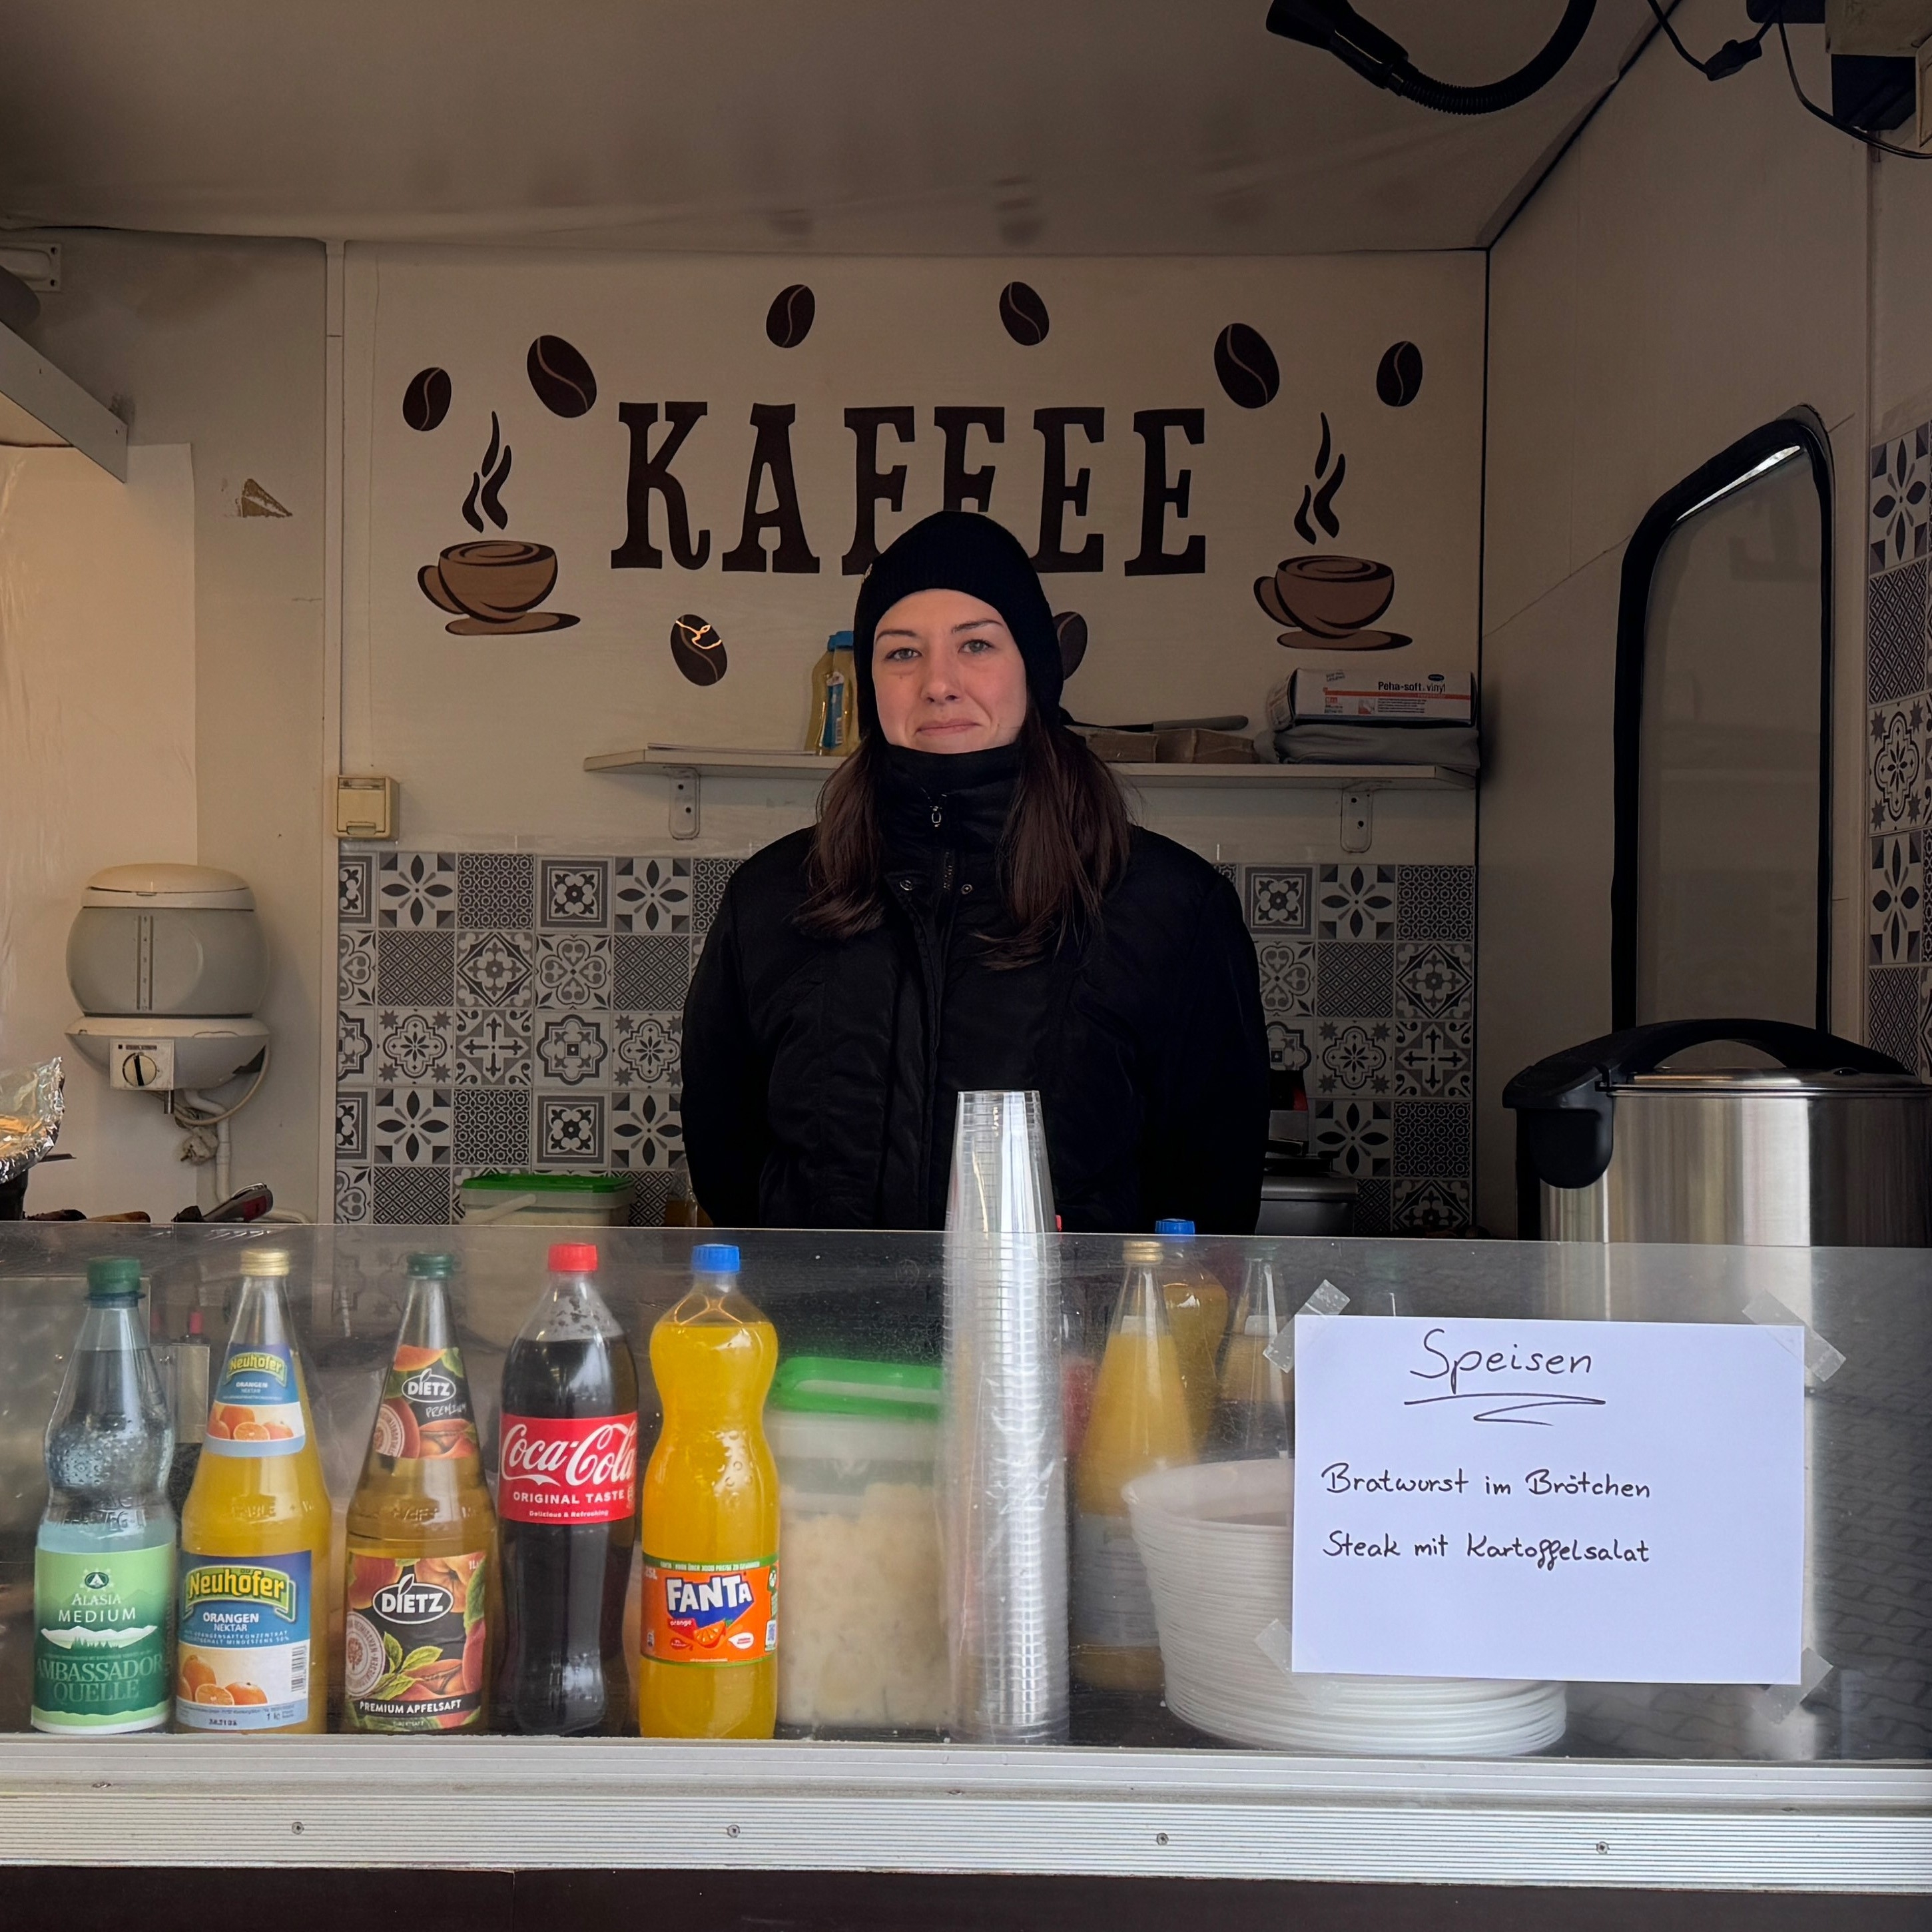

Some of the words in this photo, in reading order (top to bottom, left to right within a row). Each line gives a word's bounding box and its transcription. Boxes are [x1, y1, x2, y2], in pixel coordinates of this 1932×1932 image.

[611, 401, 1205, 577] KAFFEE
[1378, 681, 1421, 691] Peha-soft
[1427, 682, 1446, 693] vinyl
[1411, 1329, 1592, 1394] Speisen
[408, 1381, 450, 1397] DIETZ
[501, 1420, 636, 1486] Coca-Cola
[1321, 1462, 1469, 1493] Bratwurst
[1485, 1475, 1511, 1496] im
[1525, 1468, 1650, 1499] Brötchen
[513, 1491, 580, 1504] ORIGINAL
[585, 1489, 625, 1503] TASTE
[571, 1509, 609, 1518] Refreshing
[1323, 1530, 1401, 1558] Steak
[1414, 1539, 1448, 1557] mit
[1467, 1538, 1650, 1570] Kartoffelsalat
[188, 1568, 284, 1600] Neuhöfer
[667, 1575, 753, 1612] FANTA
[59, 1607, 136, 1622] MEDIUM
[382, 1592, 444, 1614] DIETZ
[202, 1612, 259, 1624] ORANGEN
[54, 1678, 139, 1704] QUELLE
[360, 1701, 404, 1714] PREMIUM
[406, 1700, 462, 1714] APFELSAFT
